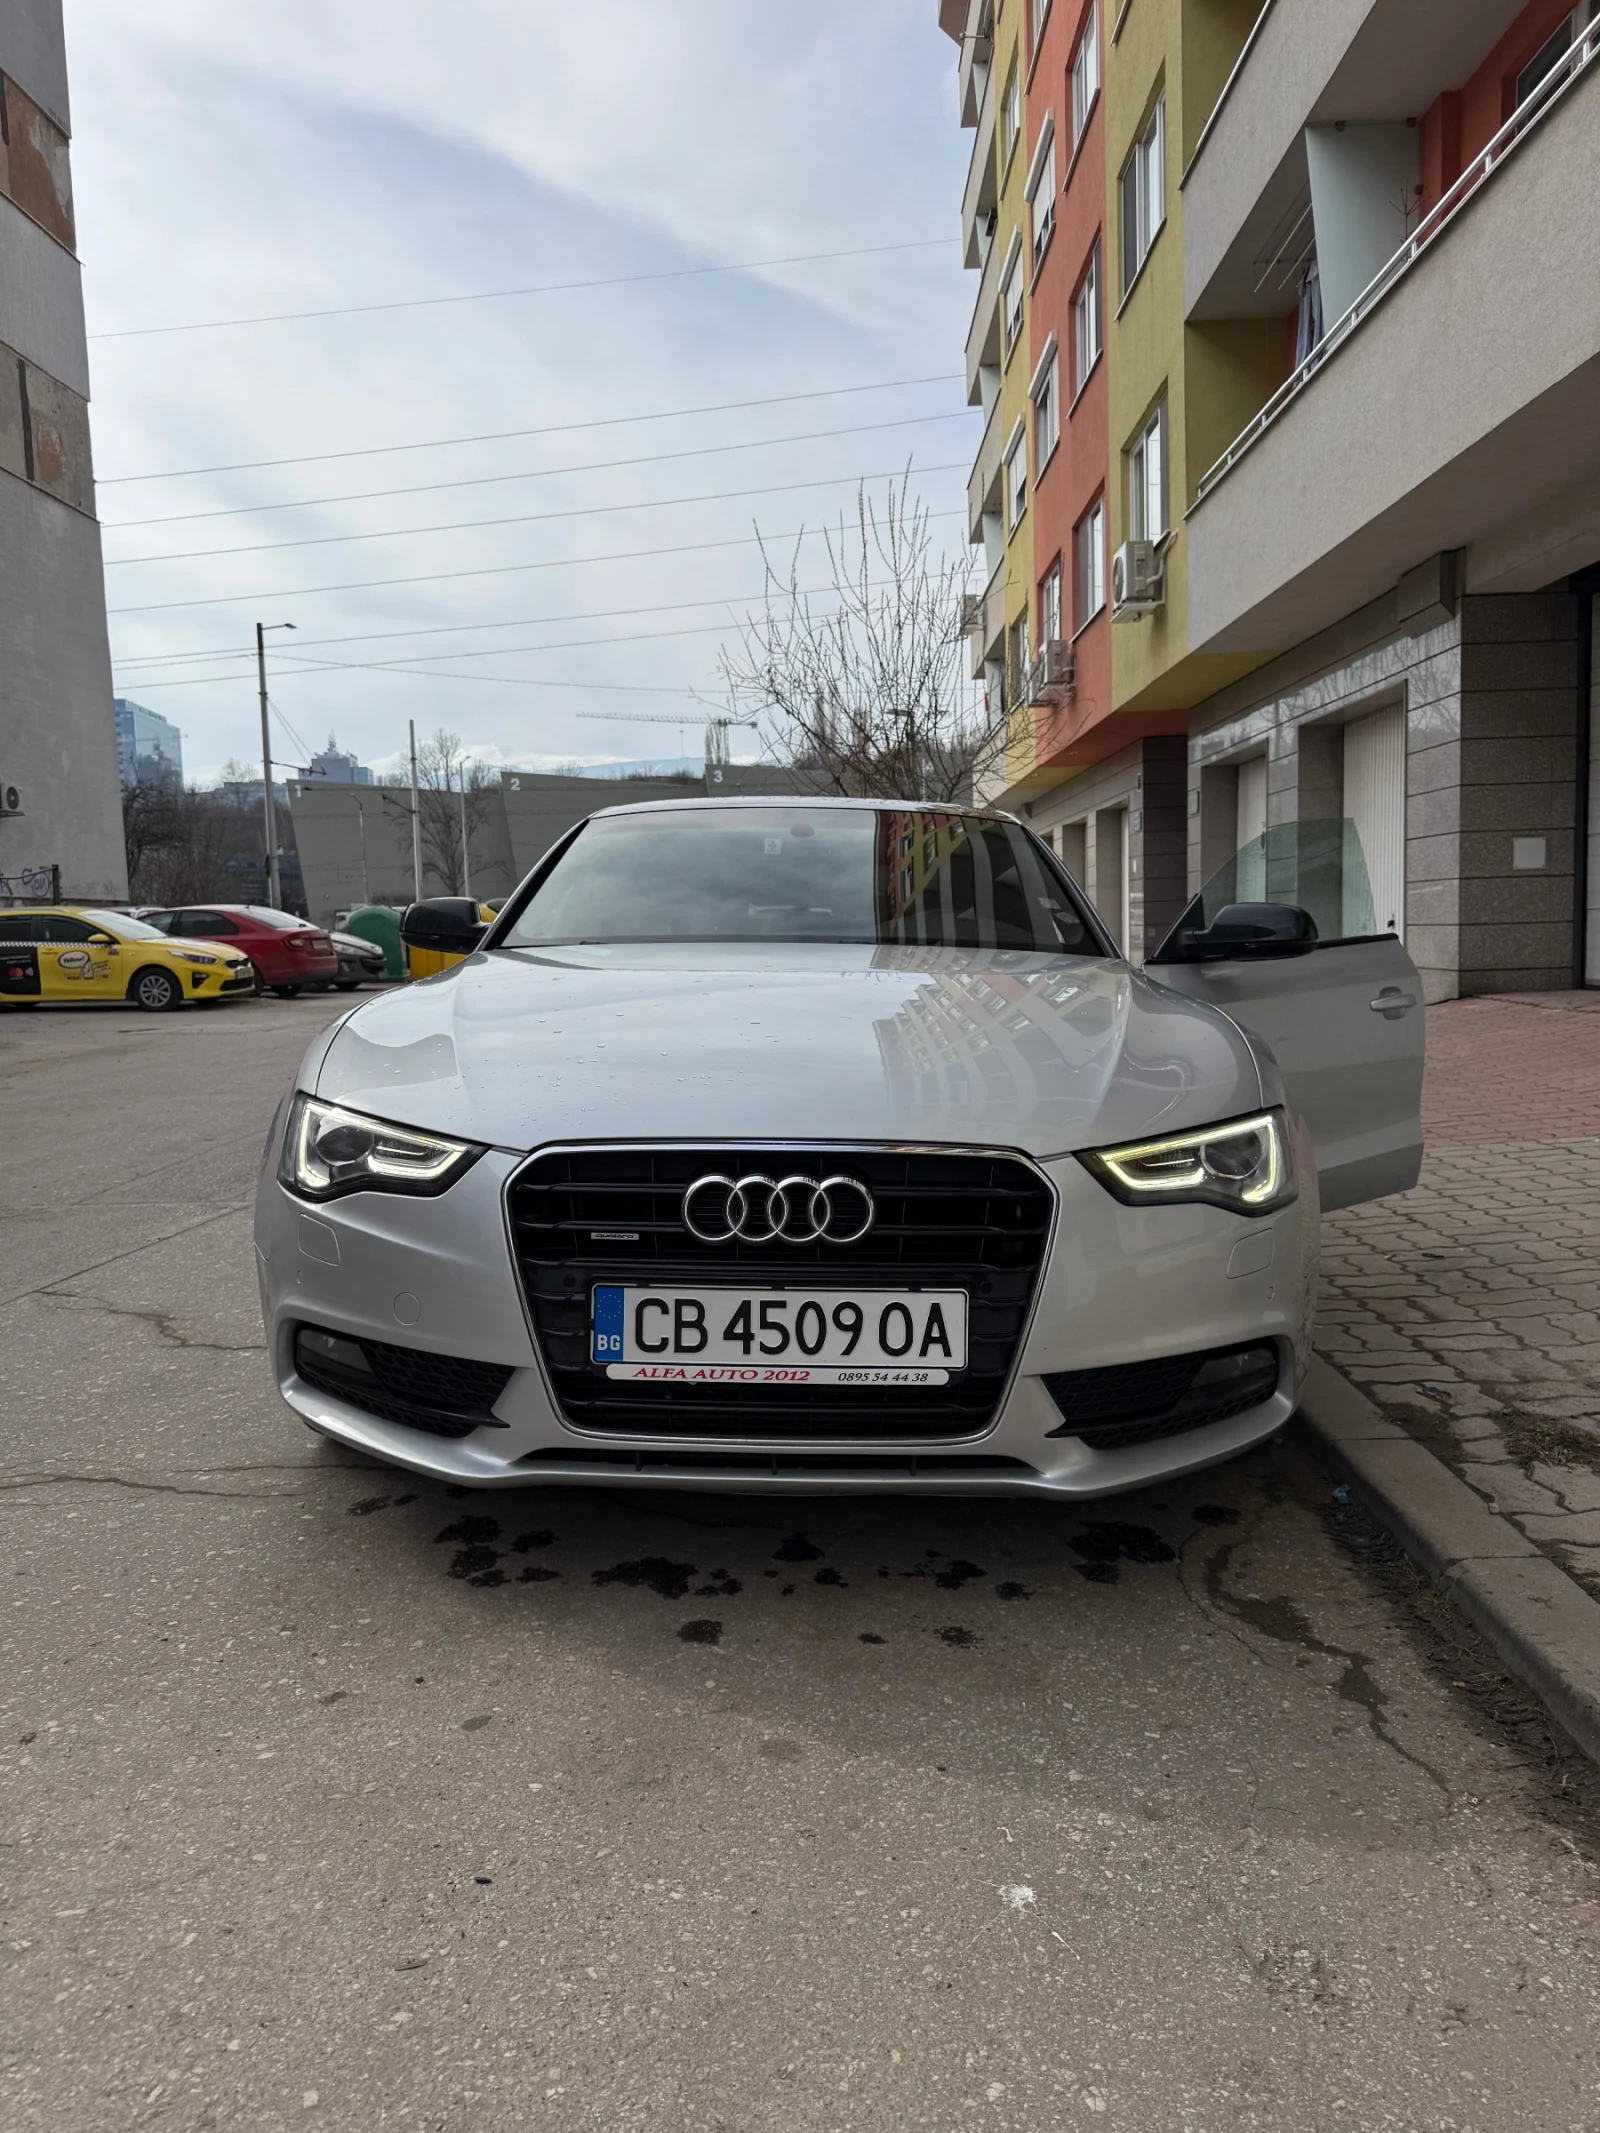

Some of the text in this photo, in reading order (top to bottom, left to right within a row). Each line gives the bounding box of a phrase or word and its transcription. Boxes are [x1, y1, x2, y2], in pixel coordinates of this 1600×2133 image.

[714, 770, 723, 782] 3
[510, 778, 520, 790] 2
[295, 785, 301, 798] 1
[634, 1297, 952, 1358] CB 4509 OA
[598, 1334, 620, 1350] BG
[632, 1368, 810, 1381] ALFA AUTO 2012
[838, 1372, 928, 1382] 0895 54 44 38
